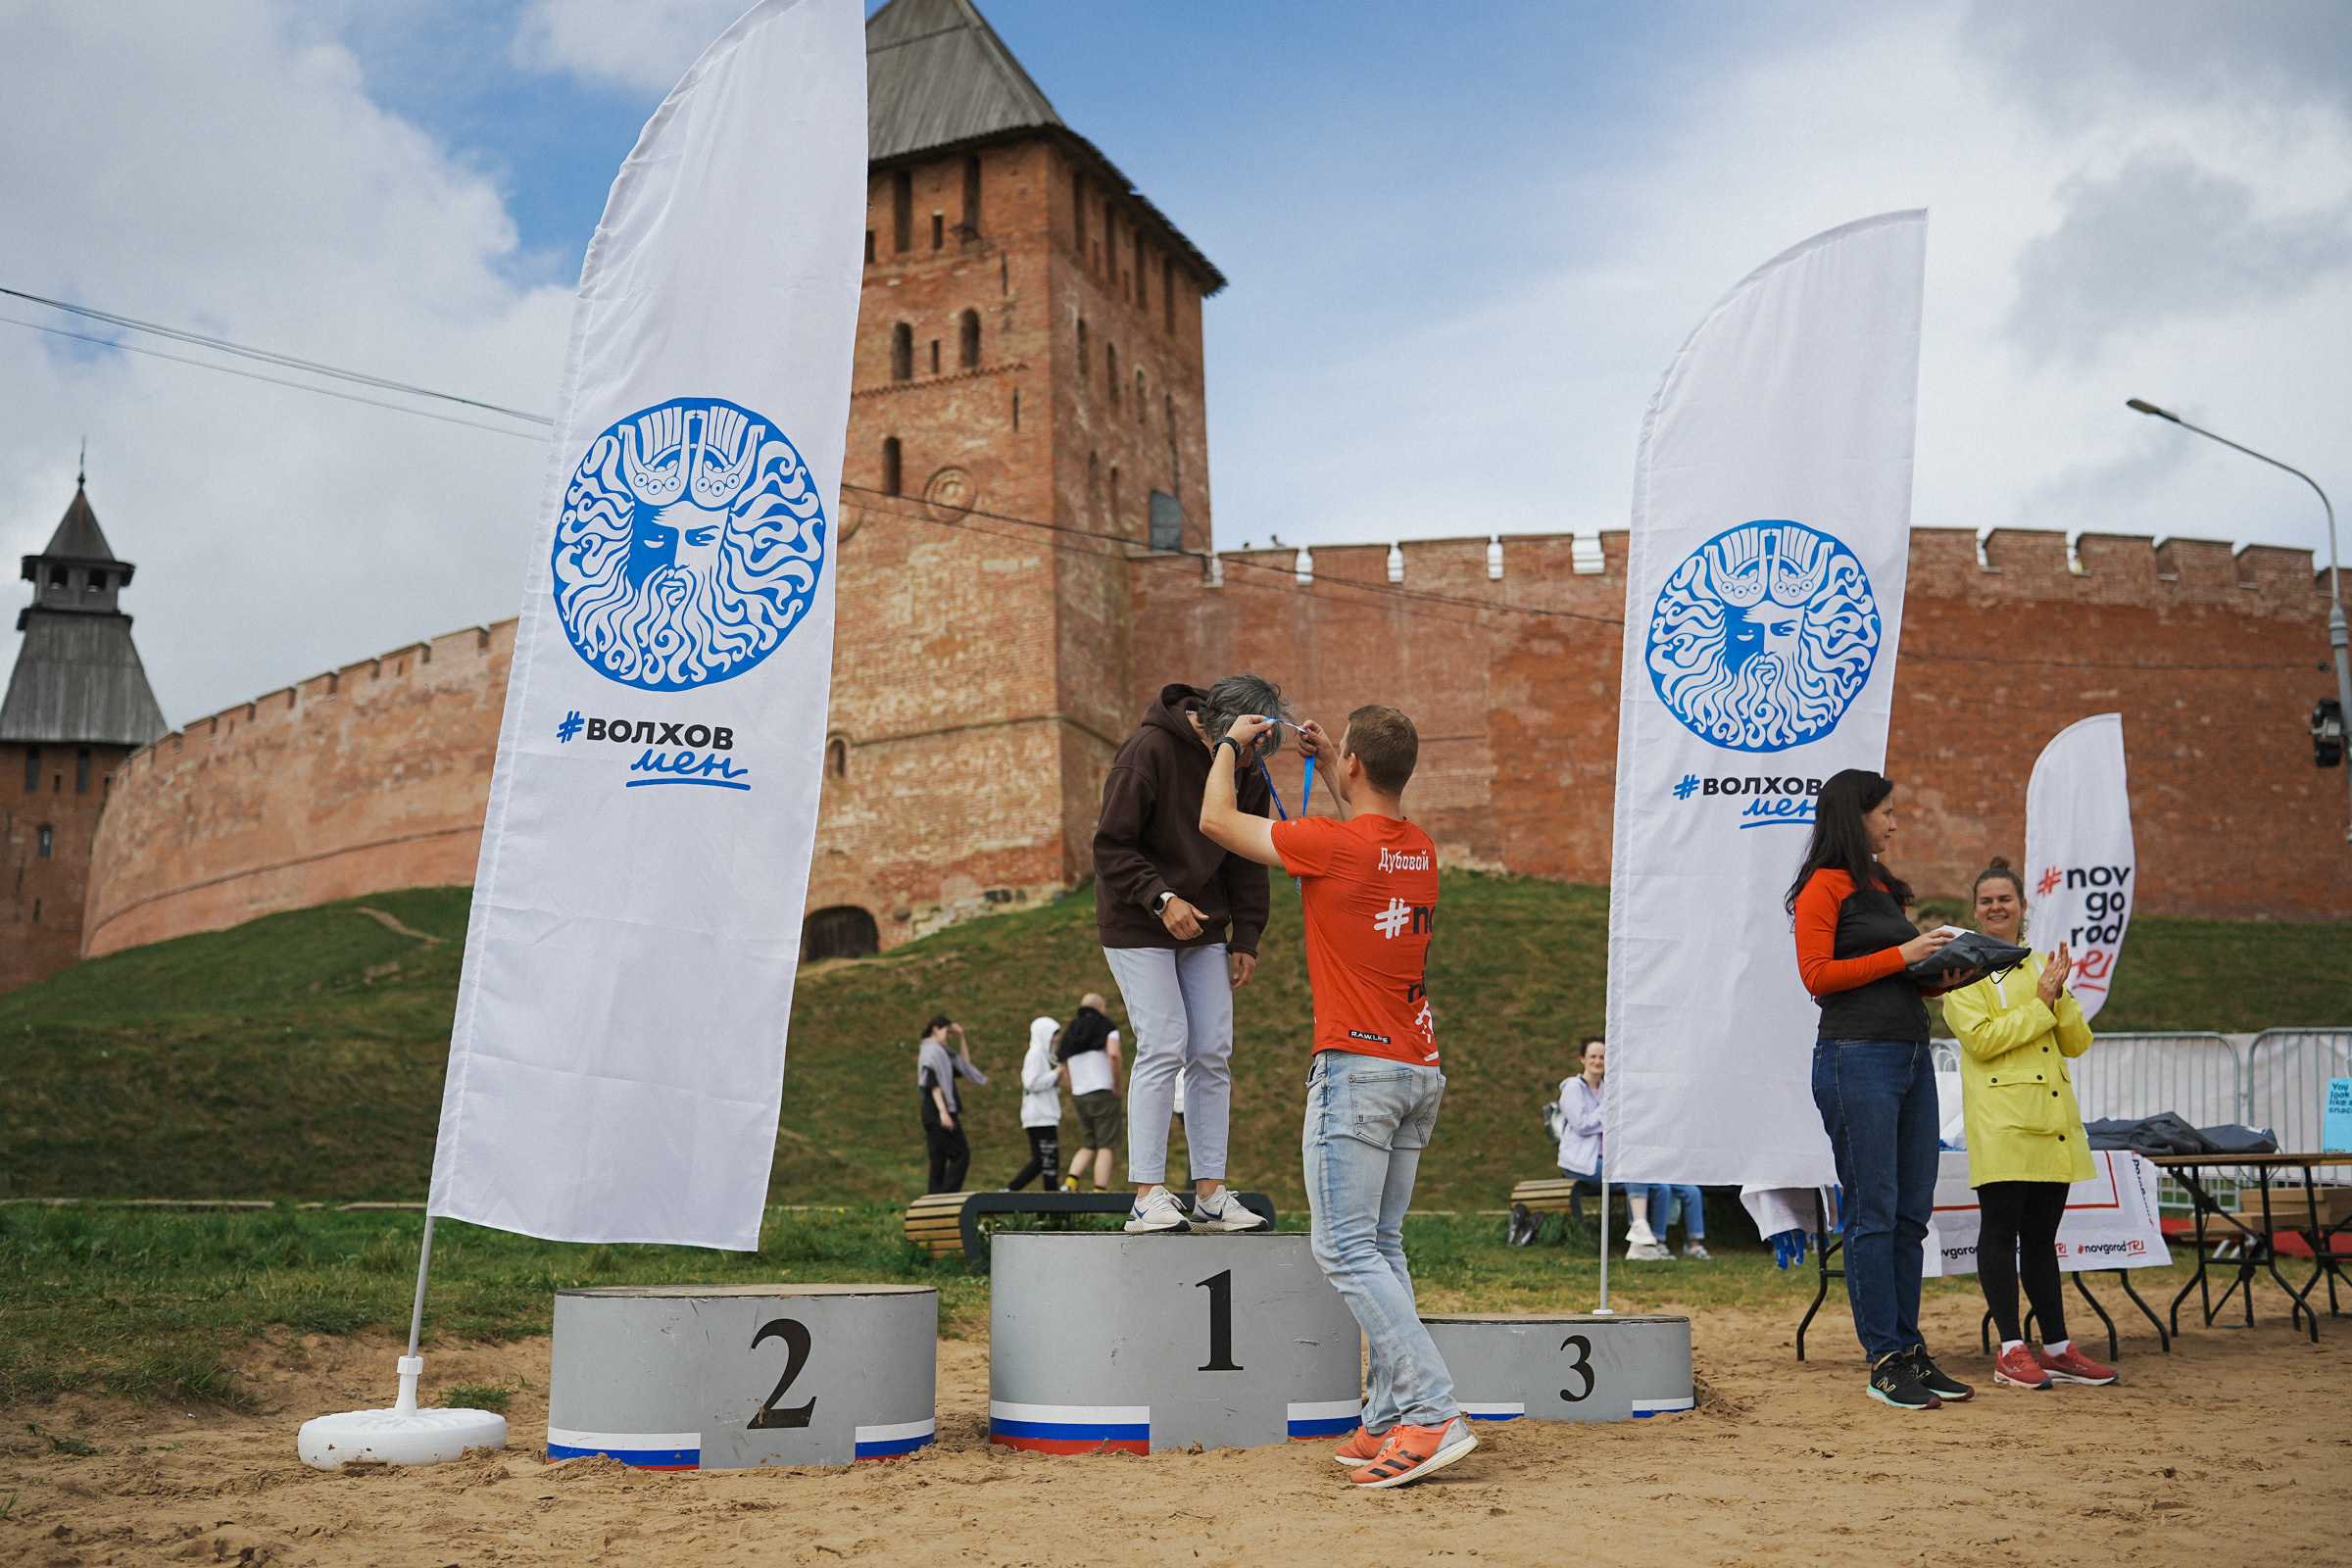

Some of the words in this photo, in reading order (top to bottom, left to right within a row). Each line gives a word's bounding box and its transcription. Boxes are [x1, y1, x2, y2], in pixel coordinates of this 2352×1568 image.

[630, 749, 749, 779] мен
[1378, 847, 1429, 874] Дубовой
[2036, 864, 2131, 897] #nov
[2085, 891, 2125, 921] go
[2071, 913, 2124, 948] rod
[1940, 1246, 1979, 1259] vgoro
[1195, 1269, 1244, 1371] 1
[746, 1318, 817, 1430] 2
[1559, 1335, 1595, 1402] 3
